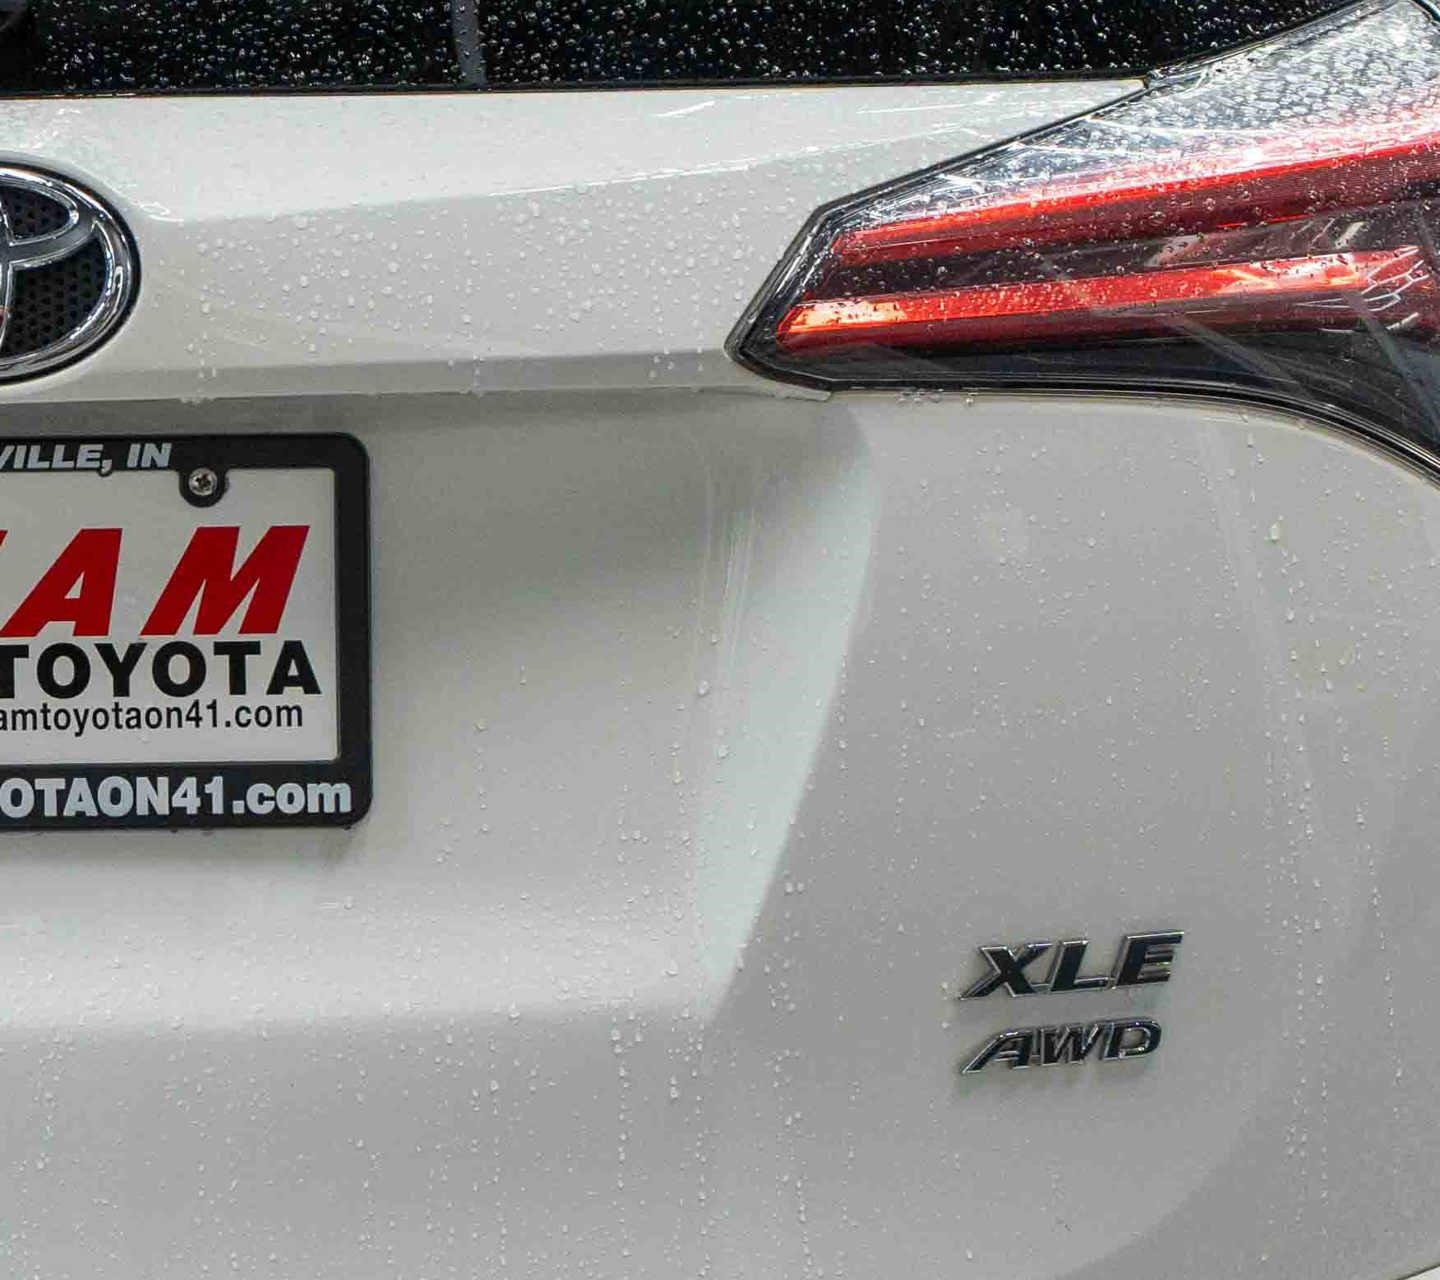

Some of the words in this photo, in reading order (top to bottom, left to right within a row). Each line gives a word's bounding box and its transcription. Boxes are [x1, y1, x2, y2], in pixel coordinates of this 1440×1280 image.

[126, 442, 173, 469] IN
[958, 928, 1185, 1001] XLE
[960, 1016, 1163, 1075] AWD
